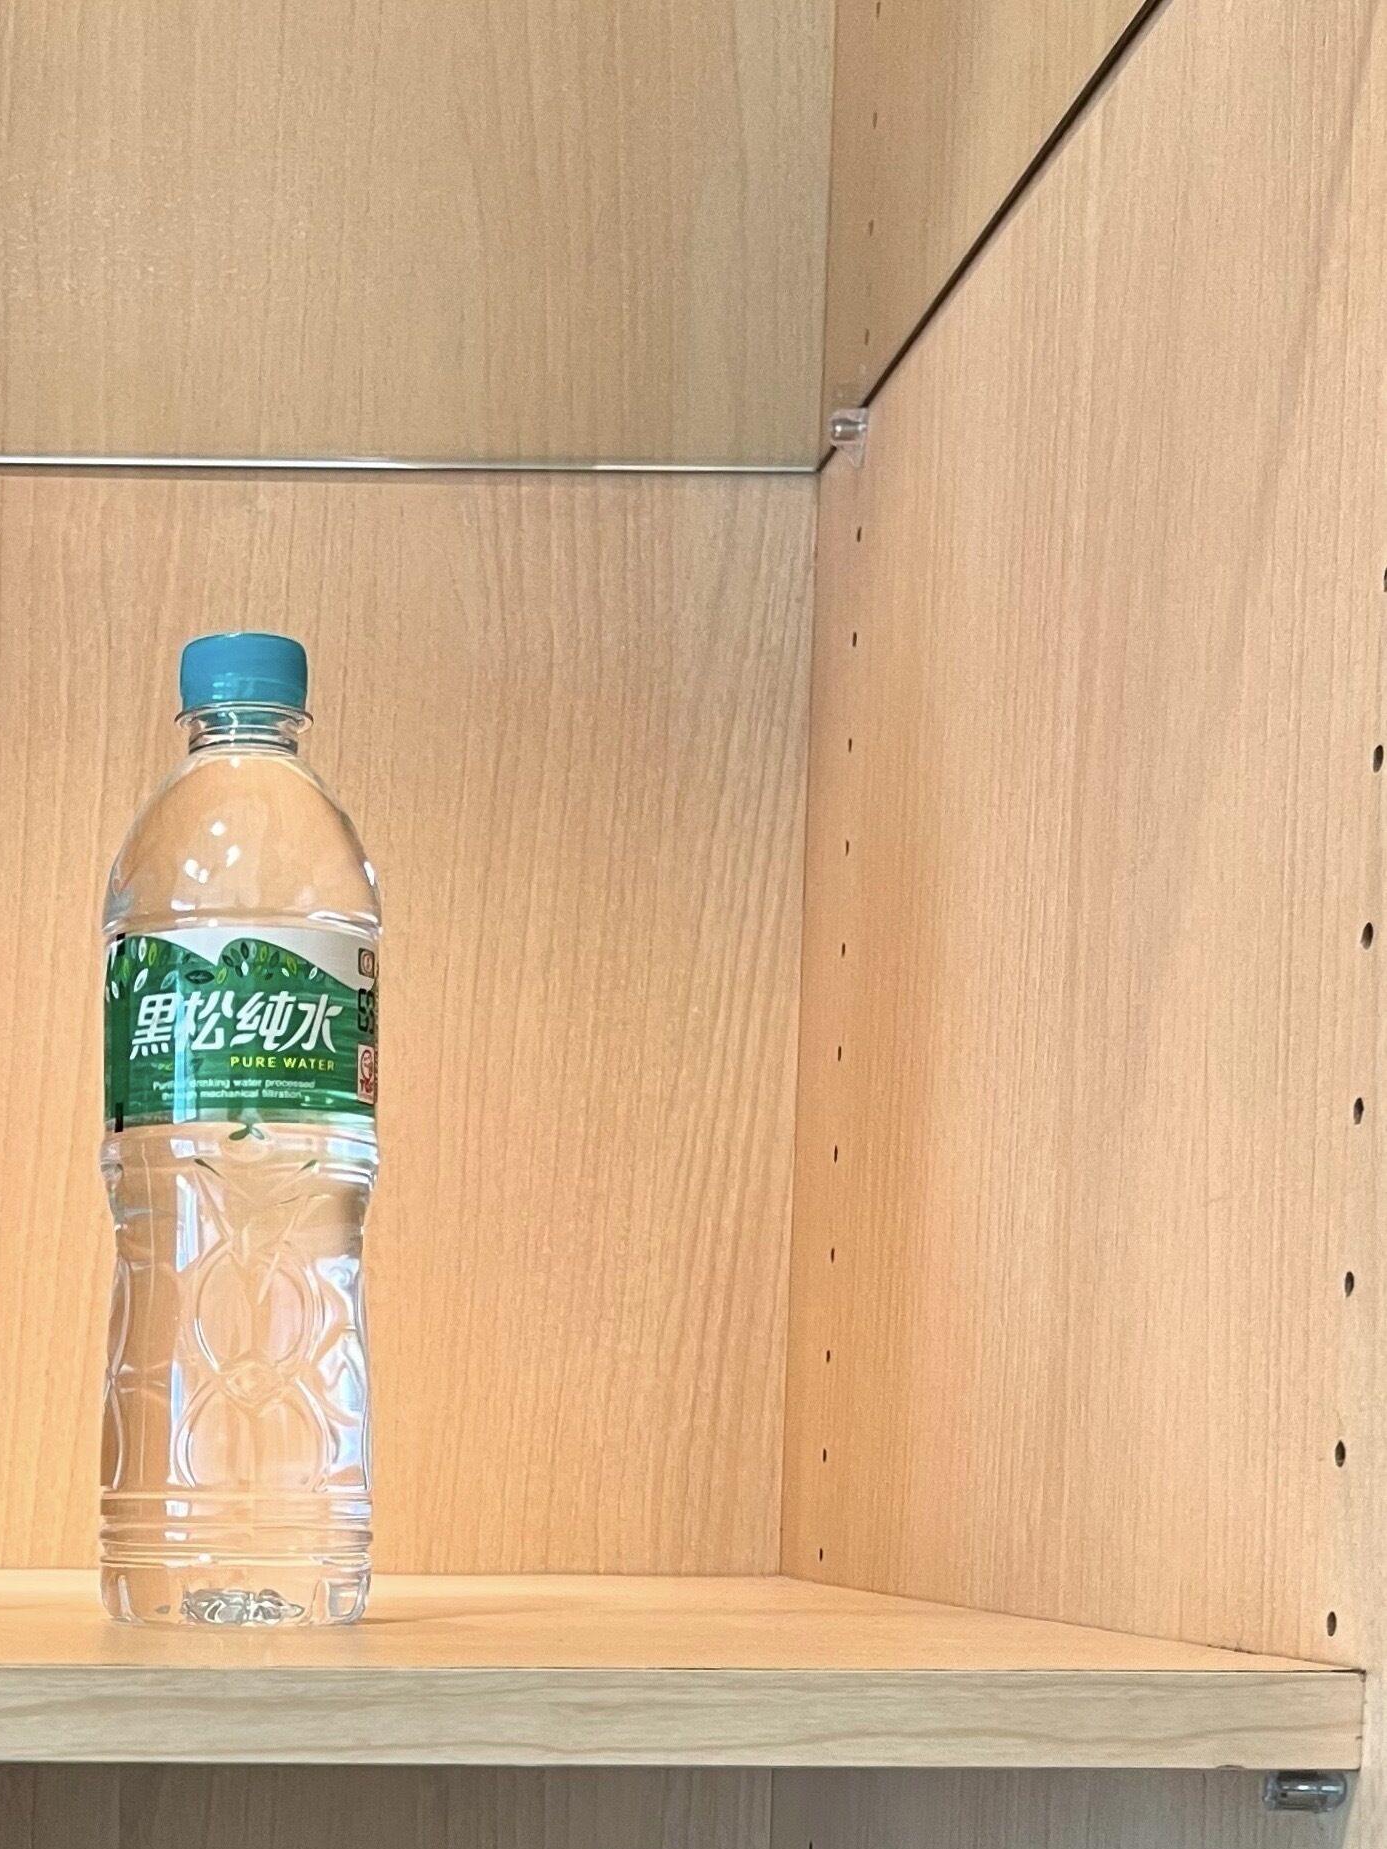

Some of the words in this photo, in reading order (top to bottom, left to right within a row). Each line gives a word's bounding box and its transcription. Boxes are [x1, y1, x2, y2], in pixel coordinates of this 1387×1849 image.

[230, 1056, 277, 1068] PURE
[283, 1057, 335, 1072] WATER
[188, 1079, 230, 1089] drinking
[232, 1078, 262, 1088] water
[264, 1078, 316, 1090] processed
[200, 1089, 259, 1099] mechanical
